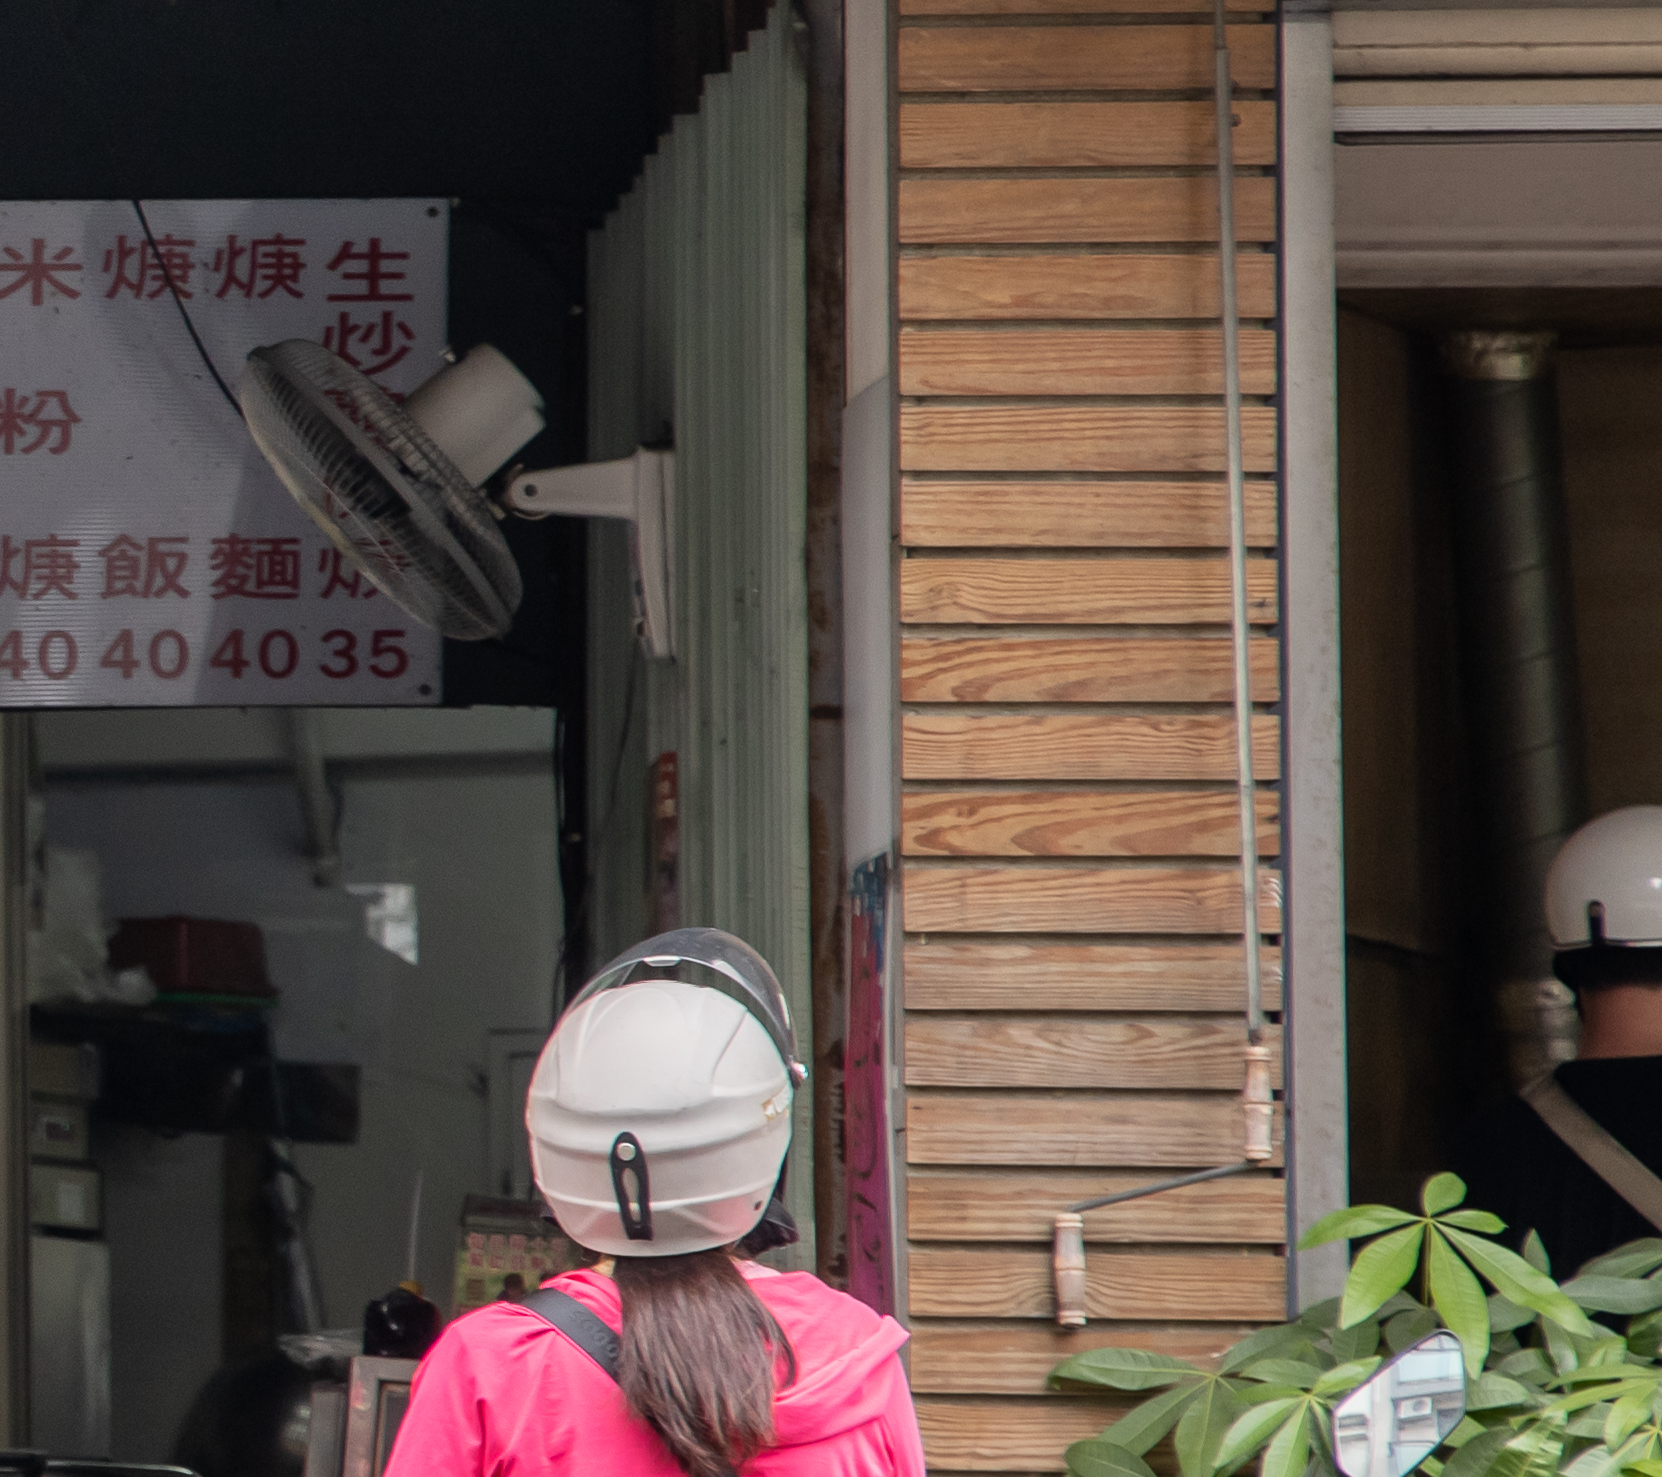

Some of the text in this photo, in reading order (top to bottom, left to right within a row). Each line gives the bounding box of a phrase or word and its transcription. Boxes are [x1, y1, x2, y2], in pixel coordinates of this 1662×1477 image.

[100, 628, 189, 680] 40
[212, 628, 300, 680] 40
[319, 628, 409, 680] 35
